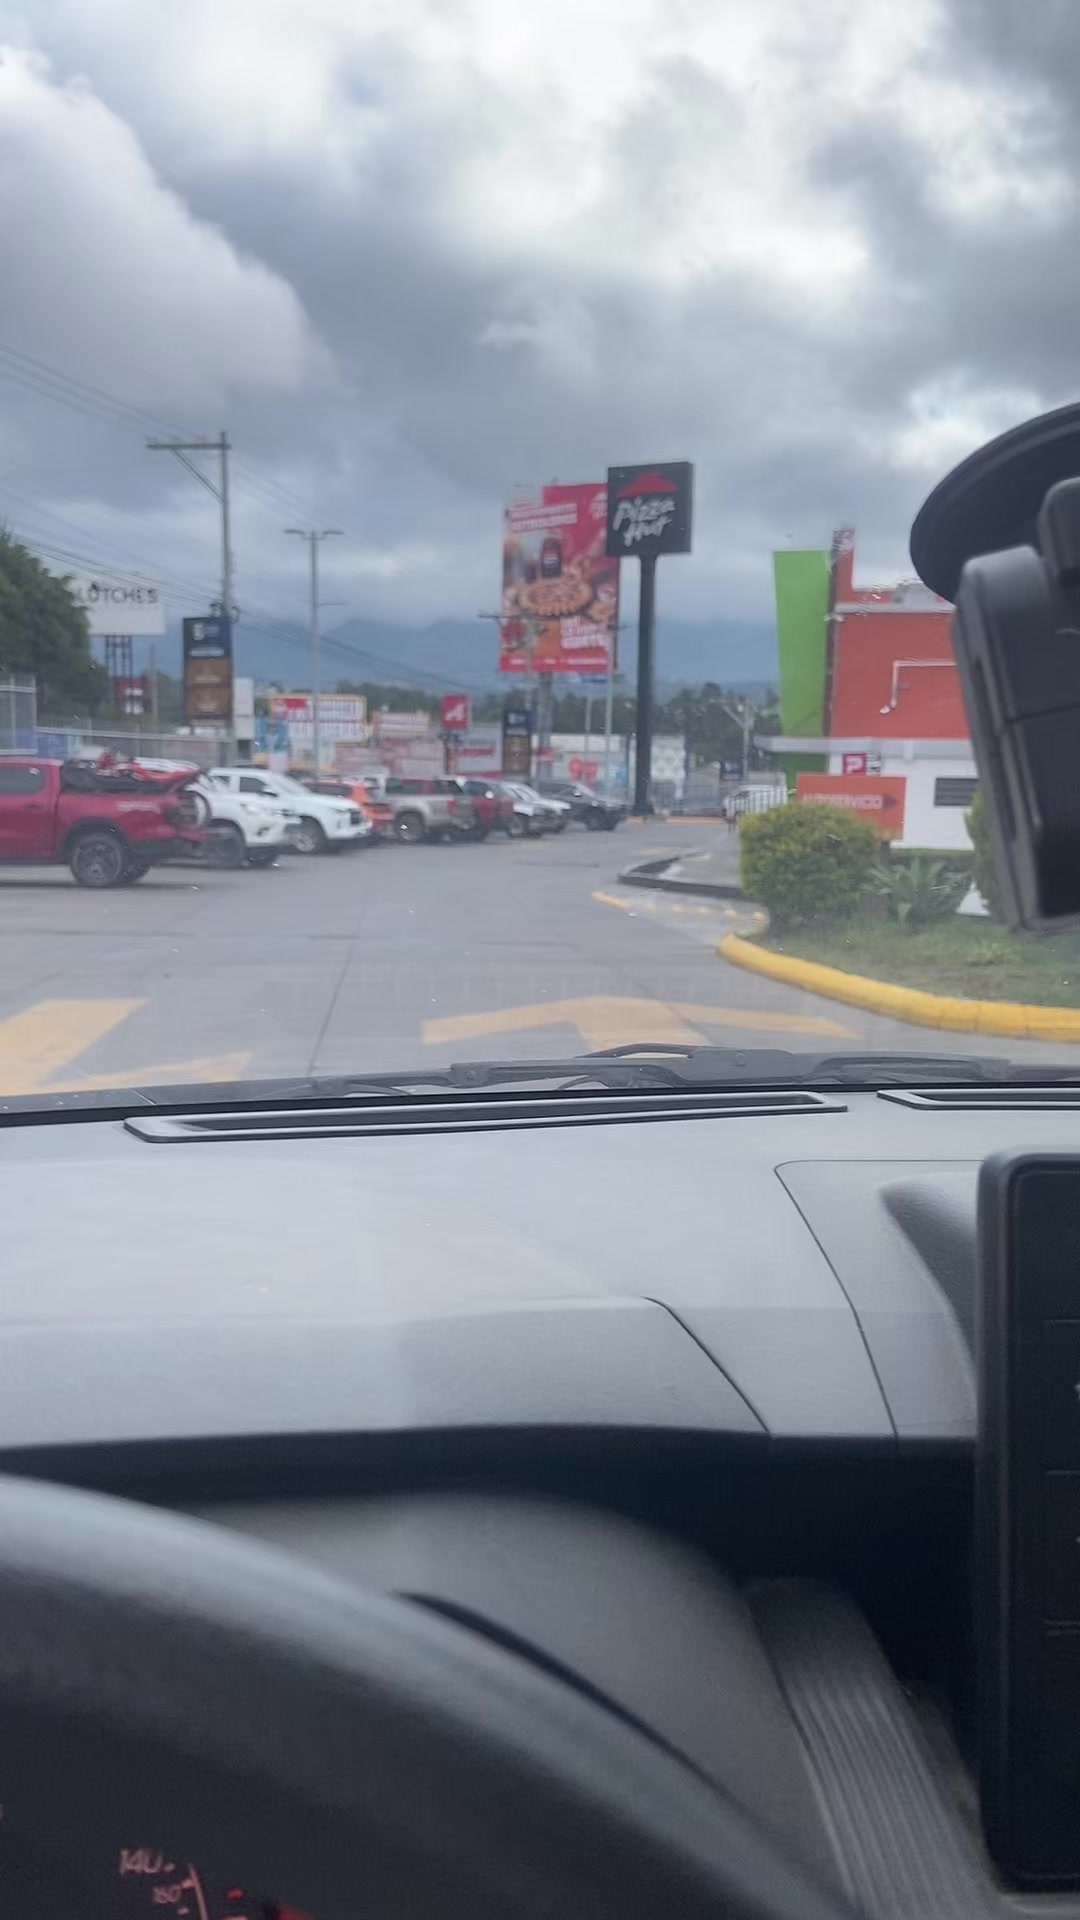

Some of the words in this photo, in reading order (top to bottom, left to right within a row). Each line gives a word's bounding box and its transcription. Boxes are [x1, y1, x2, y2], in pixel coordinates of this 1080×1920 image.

[613, 497, 675, 531] Pizza
[624, 515, 672, 547] Hut
[76, 587, 159, 605] LUTCHES
